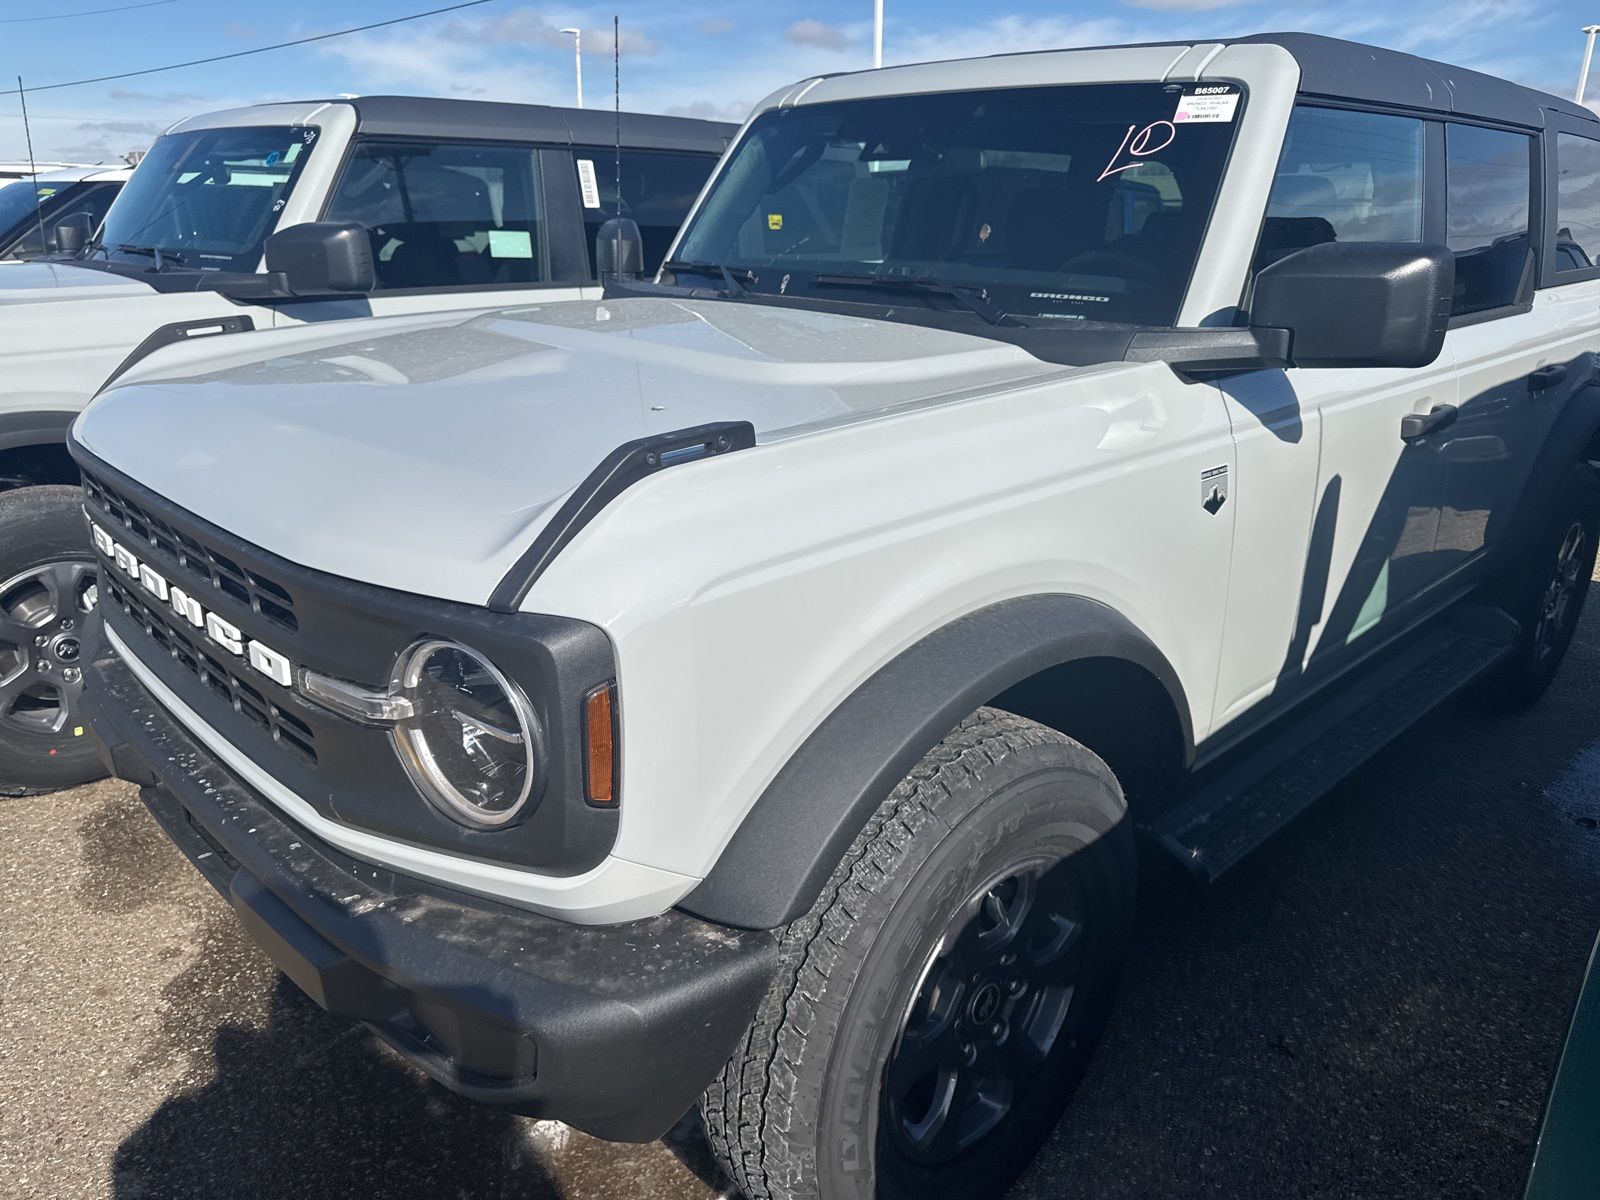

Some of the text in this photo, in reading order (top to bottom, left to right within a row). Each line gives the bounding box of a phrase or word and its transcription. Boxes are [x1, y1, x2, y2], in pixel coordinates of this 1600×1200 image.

[1194, 86, 1230, 95] B65007
[1030, 292, 1110, 303] BRONCO
[92, 523, 292, 687] BRONCO
